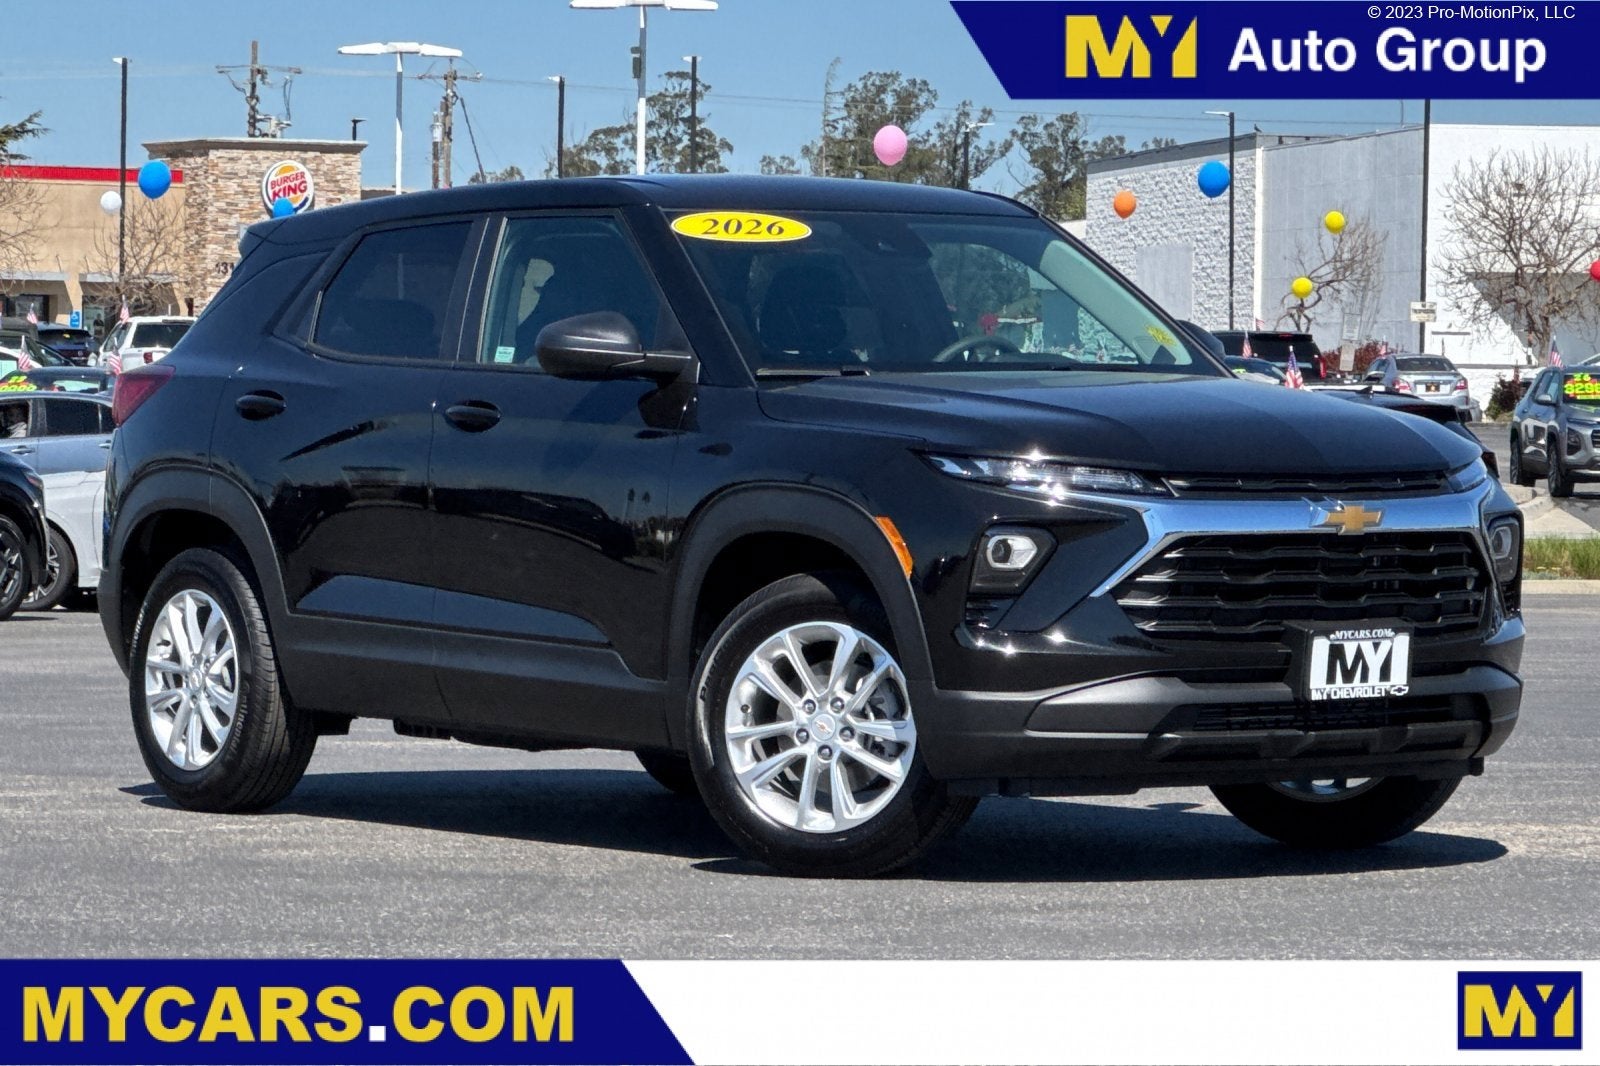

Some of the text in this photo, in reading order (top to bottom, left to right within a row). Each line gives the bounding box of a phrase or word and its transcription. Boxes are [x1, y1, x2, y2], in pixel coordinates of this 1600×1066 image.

[271, 171, 306, 190] BURGER
[272, 180, 307, 202] KING
[702, 218, 785, 236] 2026
[1333, 628, 1392, 640] MYCARS.COM
[1326, 640, 1392, 685] MY
[1311, 685, 1387, 701] MY CHEVROLET
